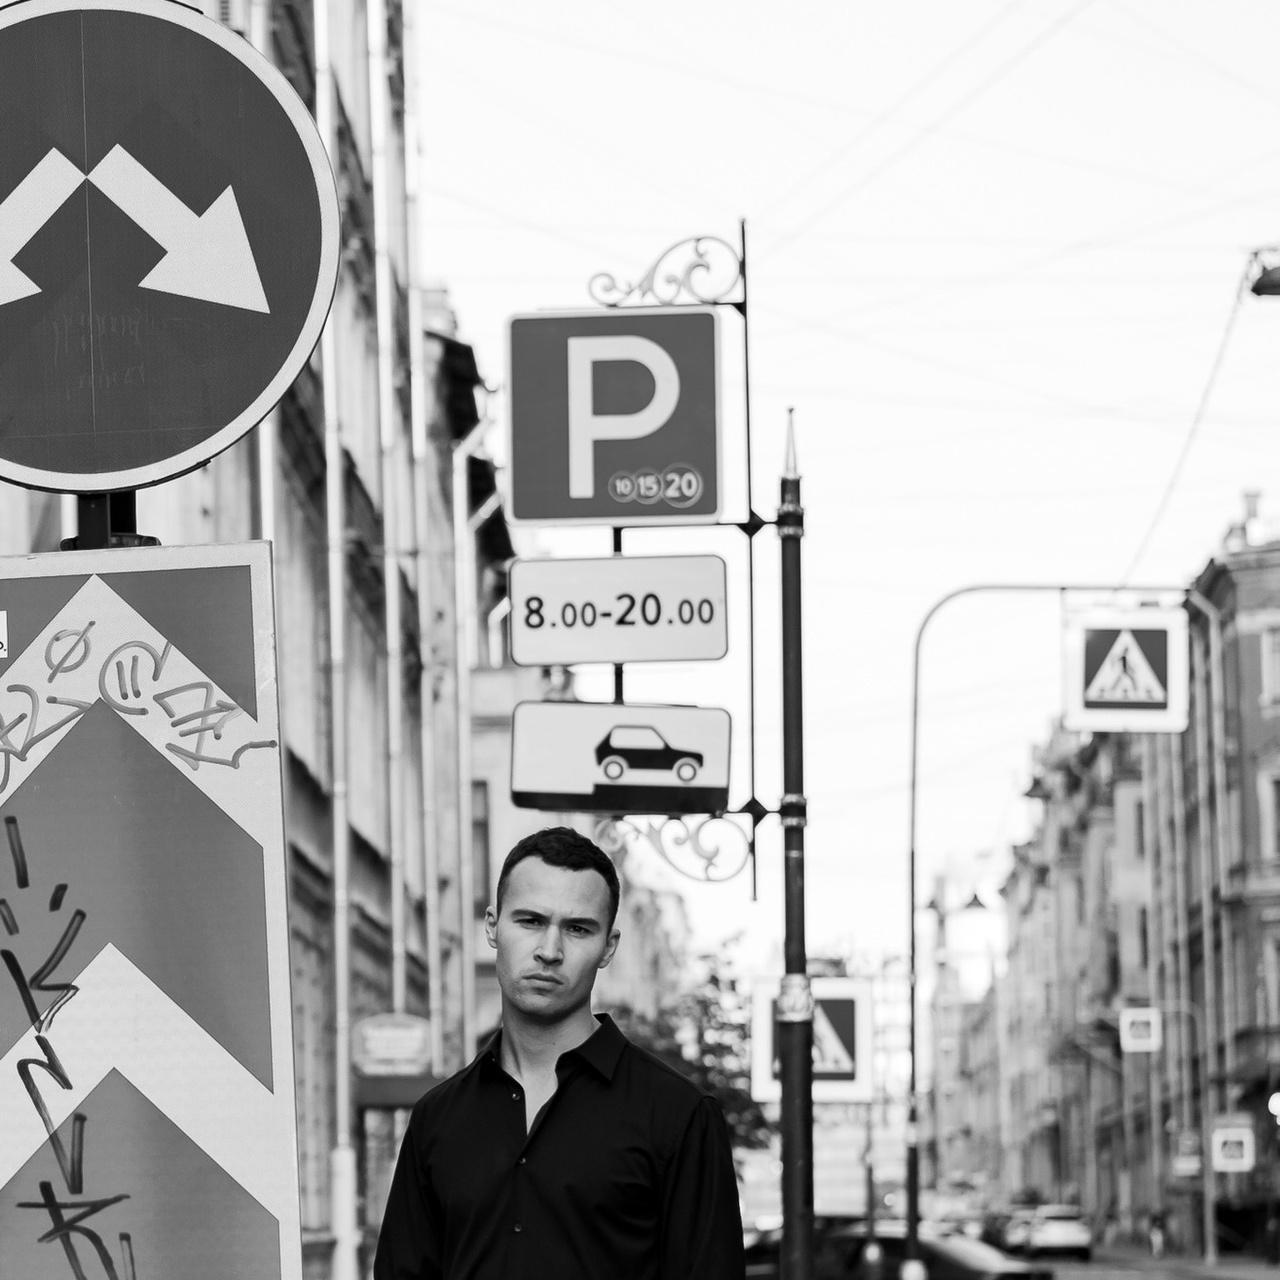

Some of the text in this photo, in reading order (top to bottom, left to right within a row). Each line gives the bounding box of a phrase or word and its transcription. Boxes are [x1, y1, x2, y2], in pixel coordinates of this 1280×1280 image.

[567, 335, 680, 499] P
[615, 471, 698, 498] 10 15 20
